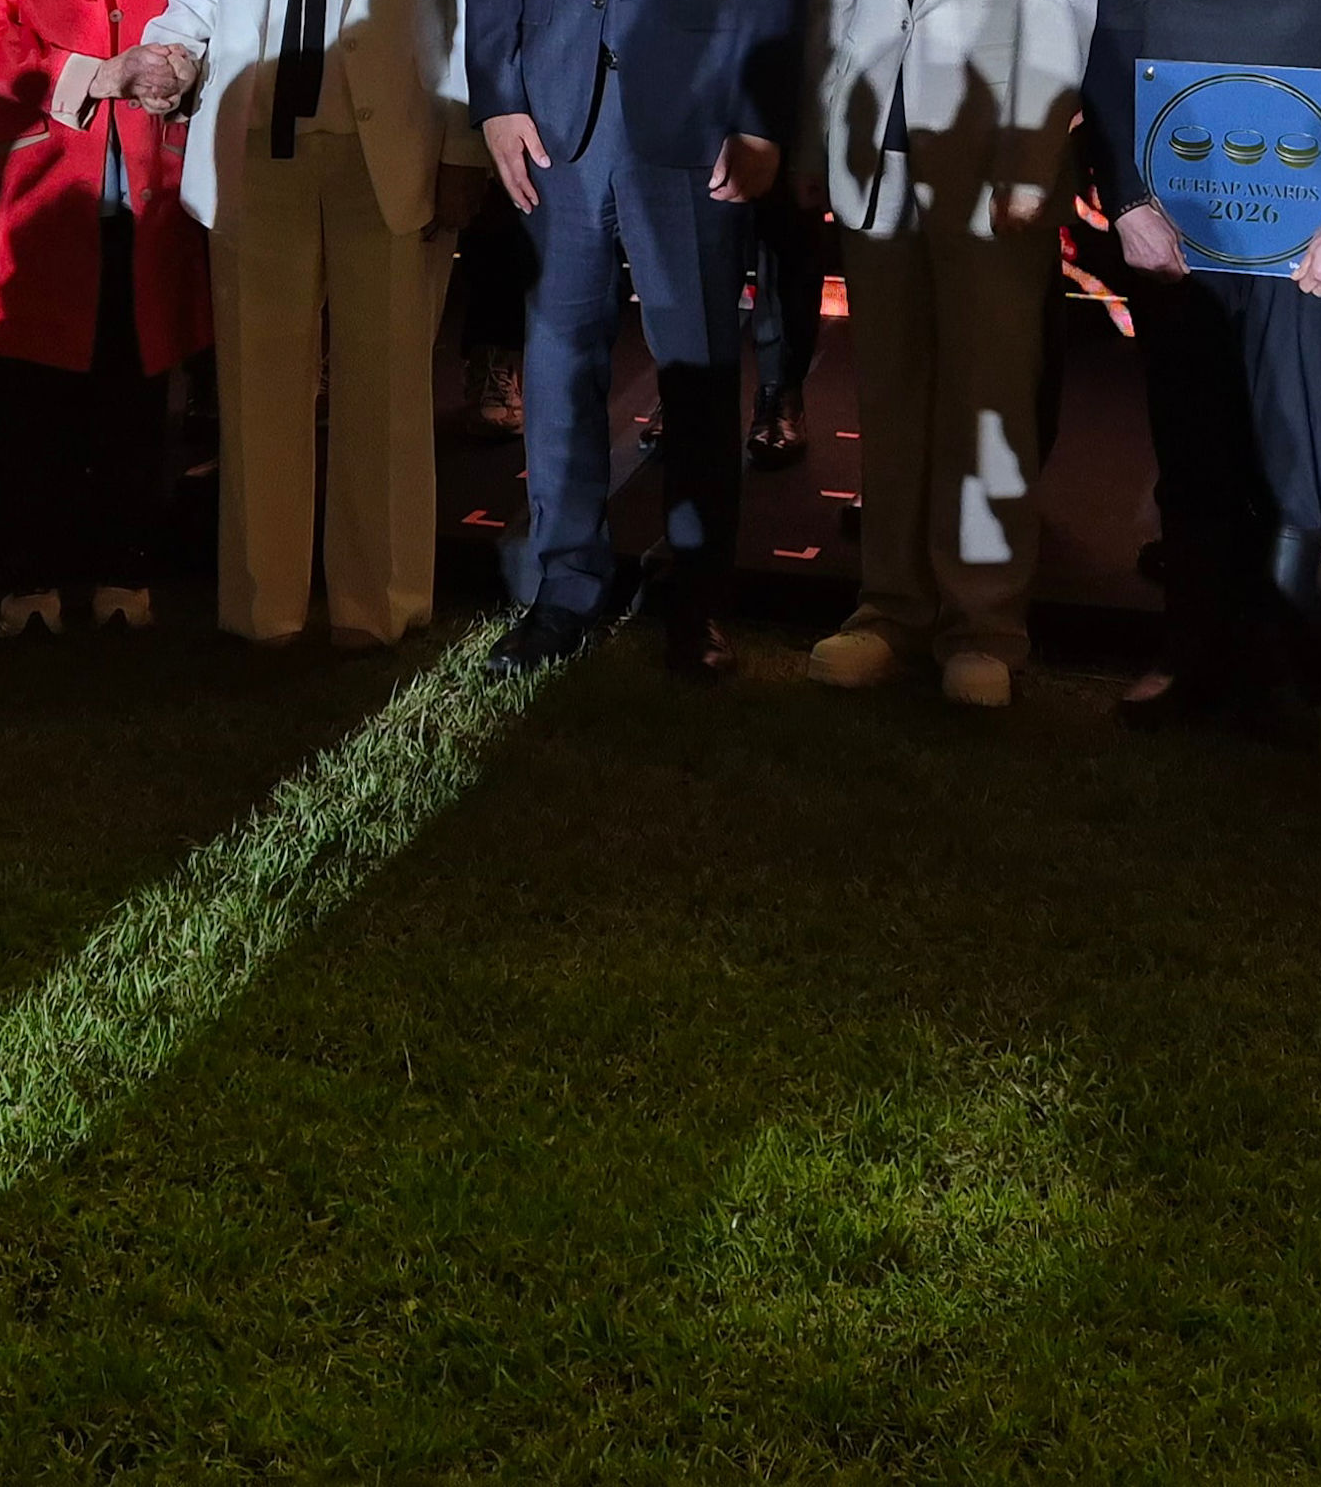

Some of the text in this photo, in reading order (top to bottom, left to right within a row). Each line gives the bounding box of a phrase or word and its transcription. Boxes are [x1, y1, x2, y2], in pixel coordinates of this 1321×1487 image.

[1168, 176, 1320, 202] GUKBAP AWARDS
[1208, 199, 1280, 225] 2026
